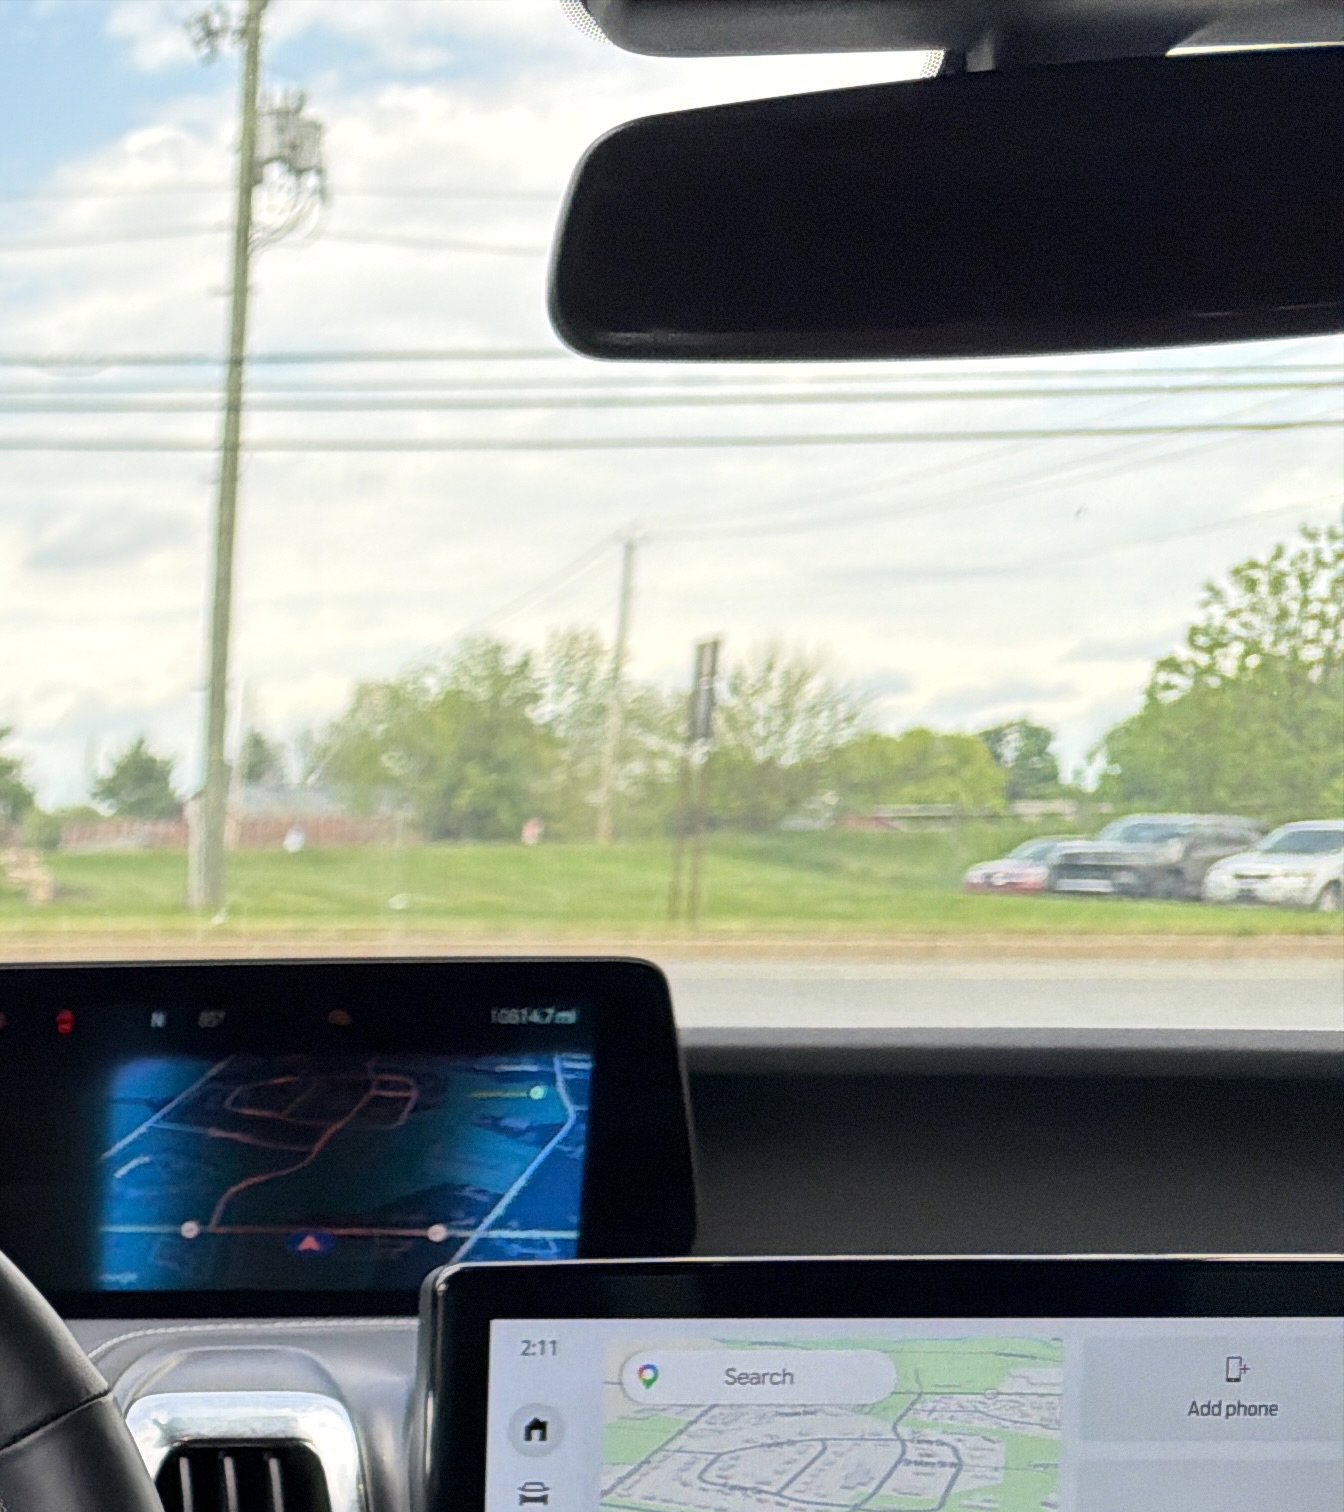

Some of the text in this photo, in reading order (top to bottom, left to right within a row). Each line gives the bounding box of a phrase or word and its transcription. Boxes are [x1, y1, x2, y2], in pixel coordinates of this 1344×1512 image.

[520, 1339, 557, 1356] 2:11
[724, 1367, 794, 1386] Search
[1187, 1400, 1279, 1419] Add phone
